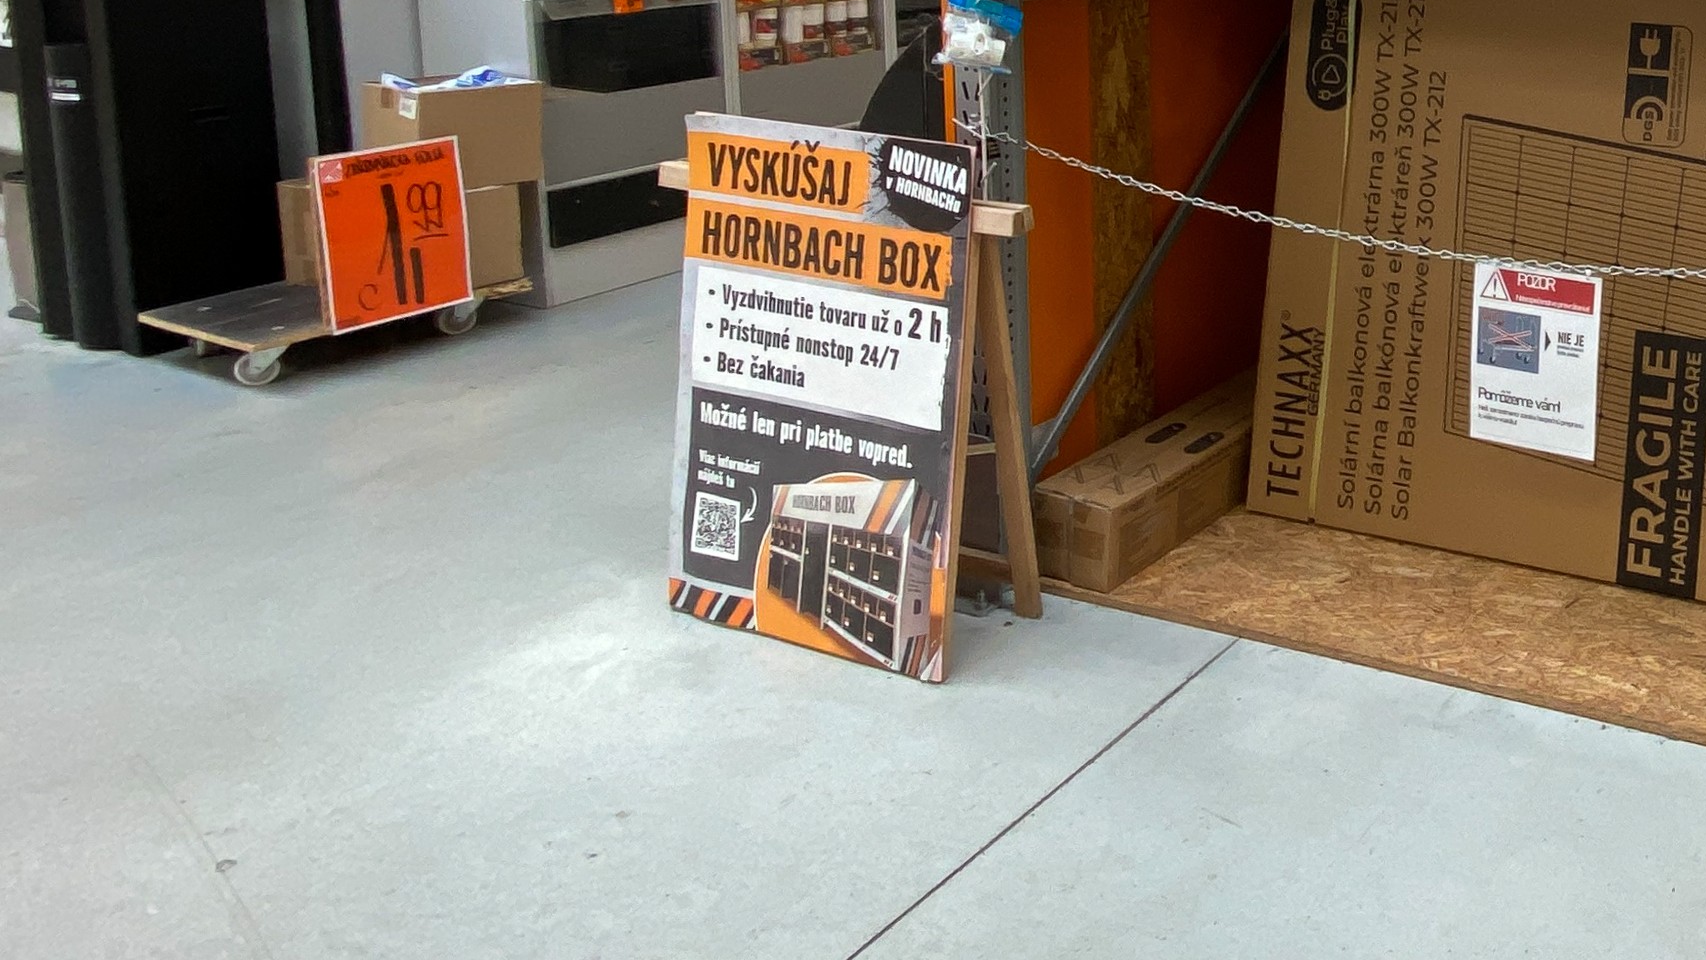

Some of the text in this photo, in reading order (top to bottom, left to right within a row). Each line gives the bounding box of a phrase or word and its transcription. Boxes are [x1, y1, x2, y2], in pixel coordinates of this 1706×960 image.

[1370, 69, 1392, 144] 300W
[1397, 63, 1419, 139] 300W
[1423, 70, 1447, 148] TX-212
[1643, 110, 1655, 142] DGS
[708, 140, 967, 205] VYSKÚŠAJ NOVINKA
[886, 177, 892, 189] v
[1388, 145, 1413, 275] elktráreň
[1416, 154, 1439, 230] 300W
[702, 210, 942, 292] HORNBACH BOX
[1517, 272, 1556, 292] POZOR
[719, 318, 899, 371] Prístupné nonstop 24/7
[722, 283, 942, 343] Vyzdvihnutie tovaru už o 2 h
[1344, 284, 1372, 416] balkonová
[1373, 282, 1401, 412] balkónová
[1557, 331, 1585, 347] NIE JE
[717, 352, 805, 388] Bez čakania
[700, 401, 913, 469] Možné len pri platbe vopred.
[1337, 421, 1361, 510] Solární
[1364, 421, 1389, 516] Solárna
[1626, 346, 1678, 578] FRAGILE
[1668, 351, 1702, 585] HANDLE WITH CARE
[835, 495, 856, 514] BOX
[1391, 455, 1412, 521] Solar
